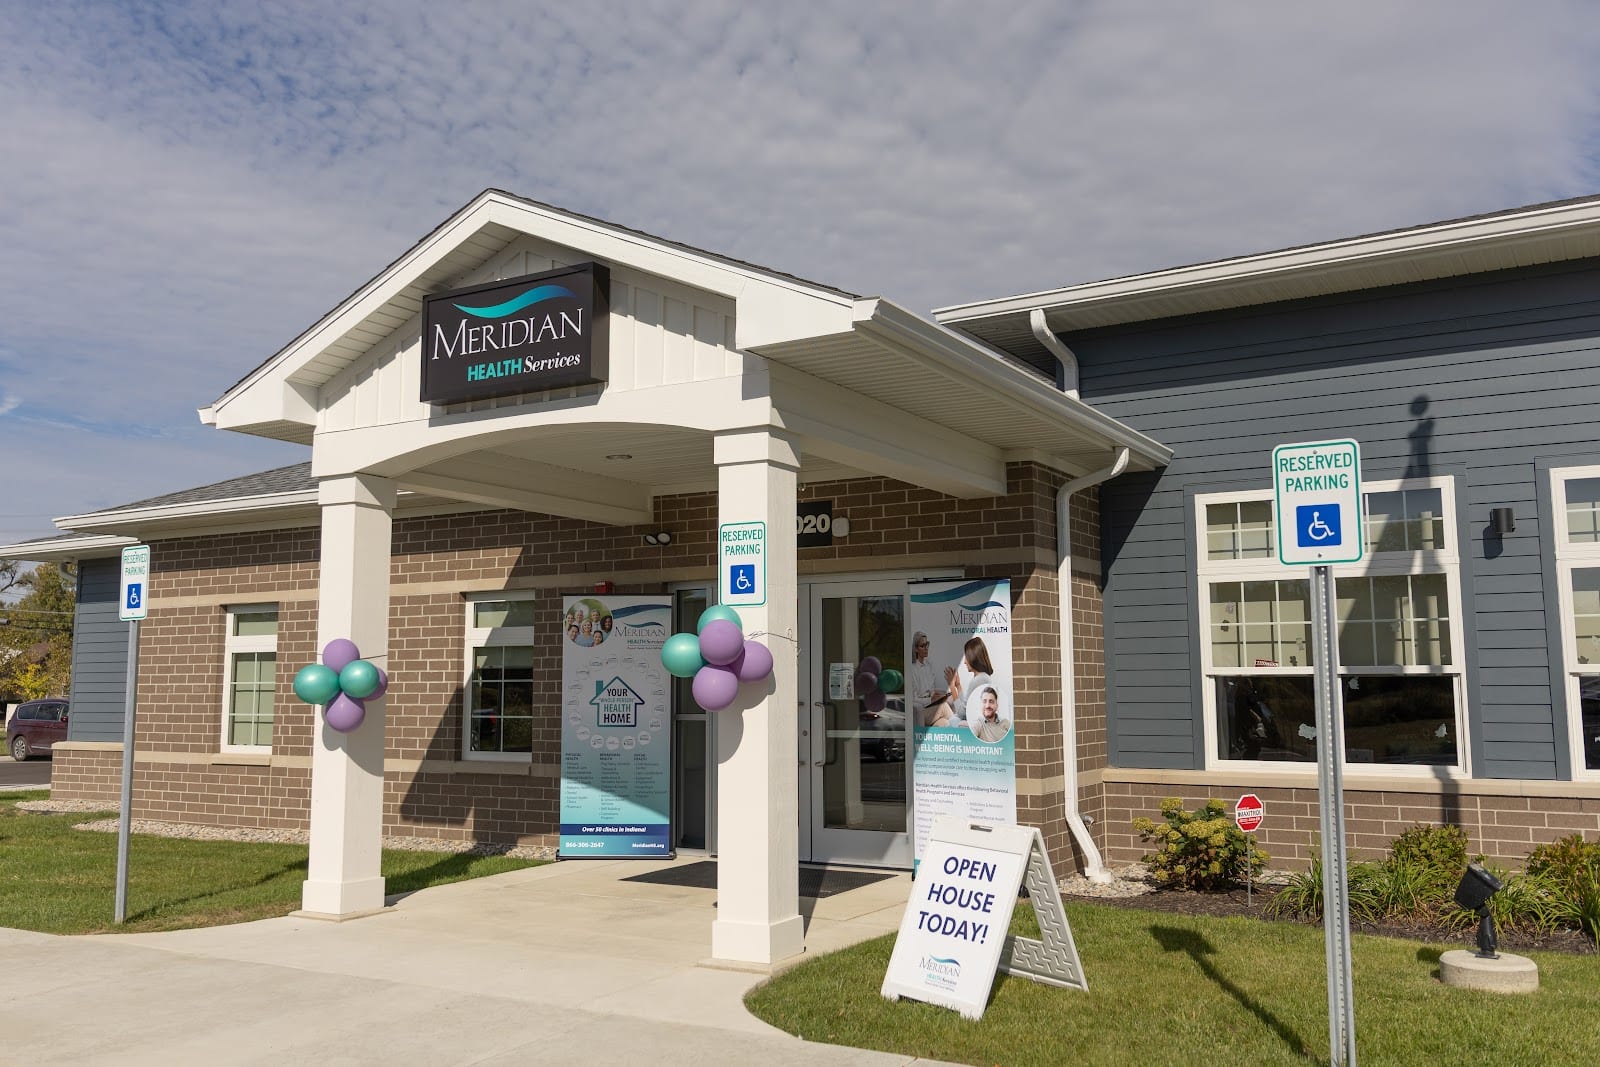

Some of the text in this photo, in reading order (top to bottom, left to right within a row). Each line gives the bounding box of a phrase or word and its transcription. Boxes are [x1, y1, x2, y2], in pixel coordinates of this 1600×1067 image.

[432, 308, 583, 360] MERIDIAN
[467, 352, 581, 382] HEALTH Services
[1280, 452, 1352, 473] RESERVED
[1285, 473, 1349, 493] PARKING
[722, 529, 763, 542] RESERVED
[725, 543, 761, 556] PARKING
[123, 553, 147, 564] RESERVED
[125, 566, 145, 576] PARKING
[950, 609, 1008, 625] MERIDIAN
[614, 626, 666, 637] MERIDIAN
[951, 626, 1008, 635] BEHAVIORAL HEALTH
[607, 688, 628, 697] YOUR
[603, 703, 631, 712] HEALTH
[603, 713, 631, 724] HOME
[933, 733, 962, 743] MENTAL
[956, 745, 962, 754] IS
[963, 745, 1003, 756] IMPORTANT
[944, 856, 997, 882] OPEN
[927, 883, 995, 913] HOUSE
[917, 911, 989, 944] TODAY!
